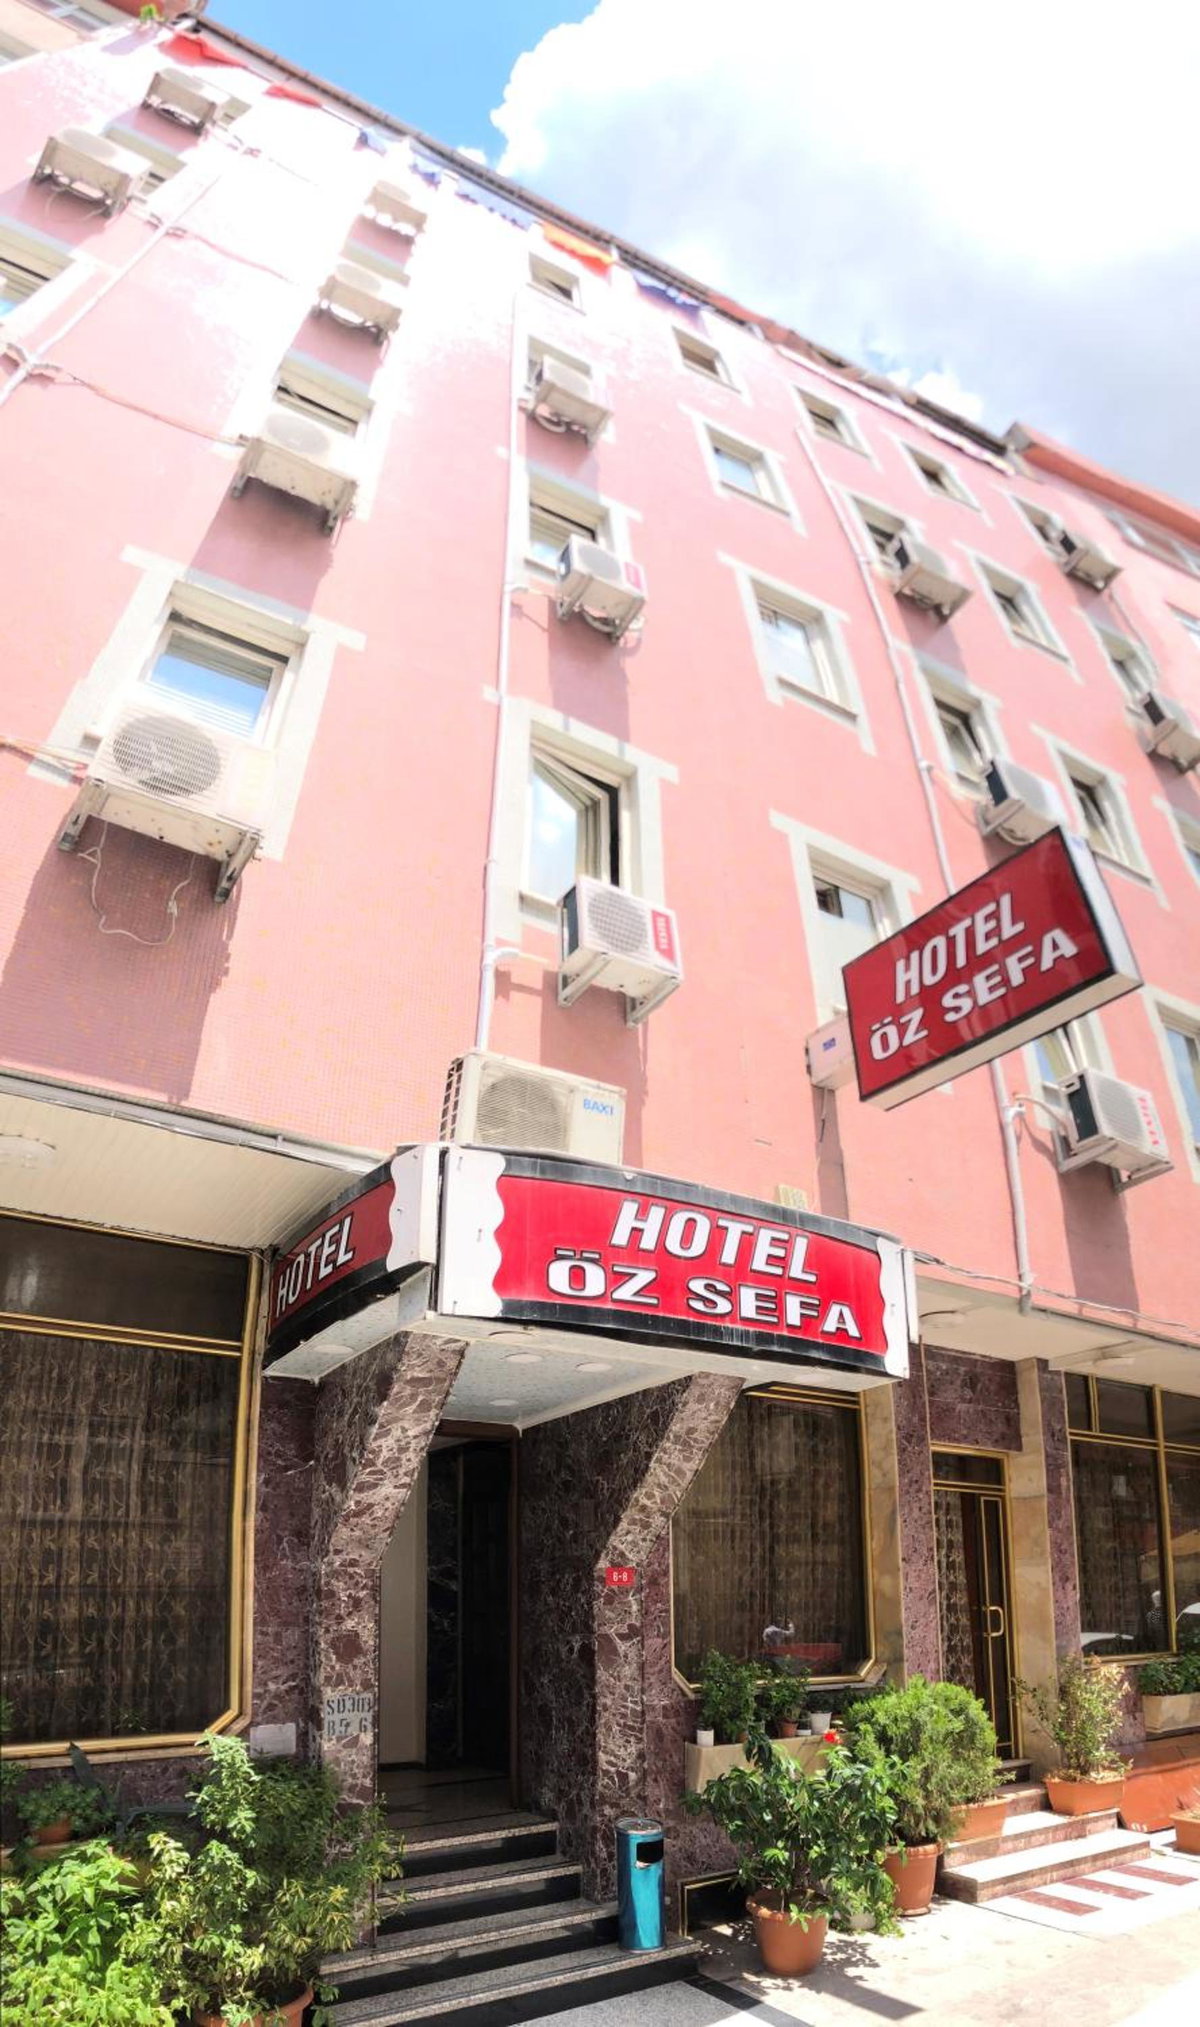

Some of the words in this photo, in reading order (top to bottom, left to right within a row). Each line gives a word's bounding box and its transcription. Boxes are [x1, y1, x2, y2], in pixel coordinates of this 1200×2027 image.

[869, 1007, 928, 1061] ÖZ
[942, 927, 1078, 1024] SEFA
[894, 893, 1025, 1003] HOTEL
[583, 1098, 614, 1115] BAXI
[276, 1213, 356, 1320] HOTEL
[608, 1198, 819, 1285] HOTEL
[547, 1246, 660, 1307] ÖZ
[687, 1276, 862, 1341] SEFA
